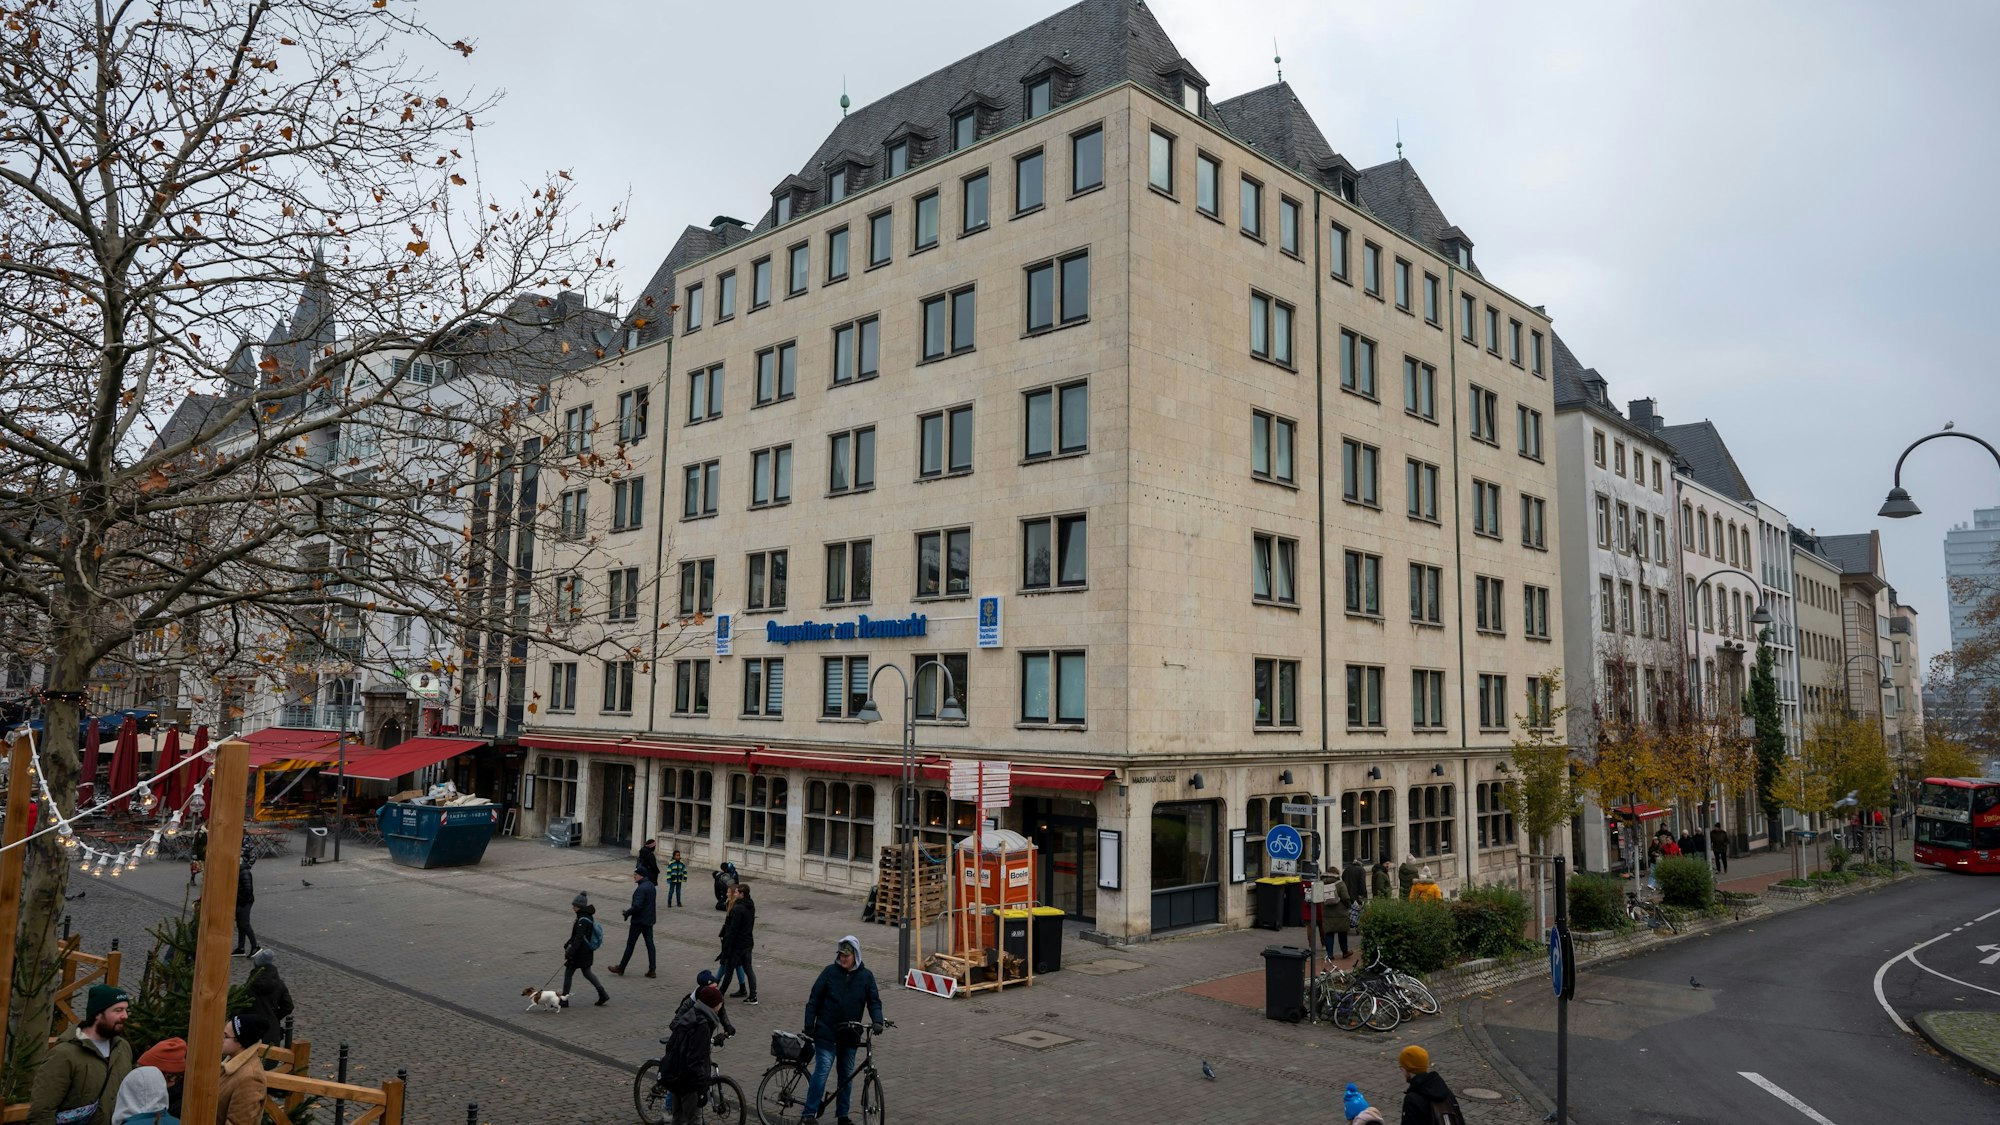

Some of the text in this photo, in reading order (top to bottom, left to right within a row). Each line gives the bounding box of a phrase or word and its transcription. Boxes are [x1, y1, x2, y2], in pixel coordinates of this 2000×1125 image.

[766, 620, 834, 645] Augustiner
[834, 622, 855, 640] am
[1010, 870, 1028, 880] Boels
